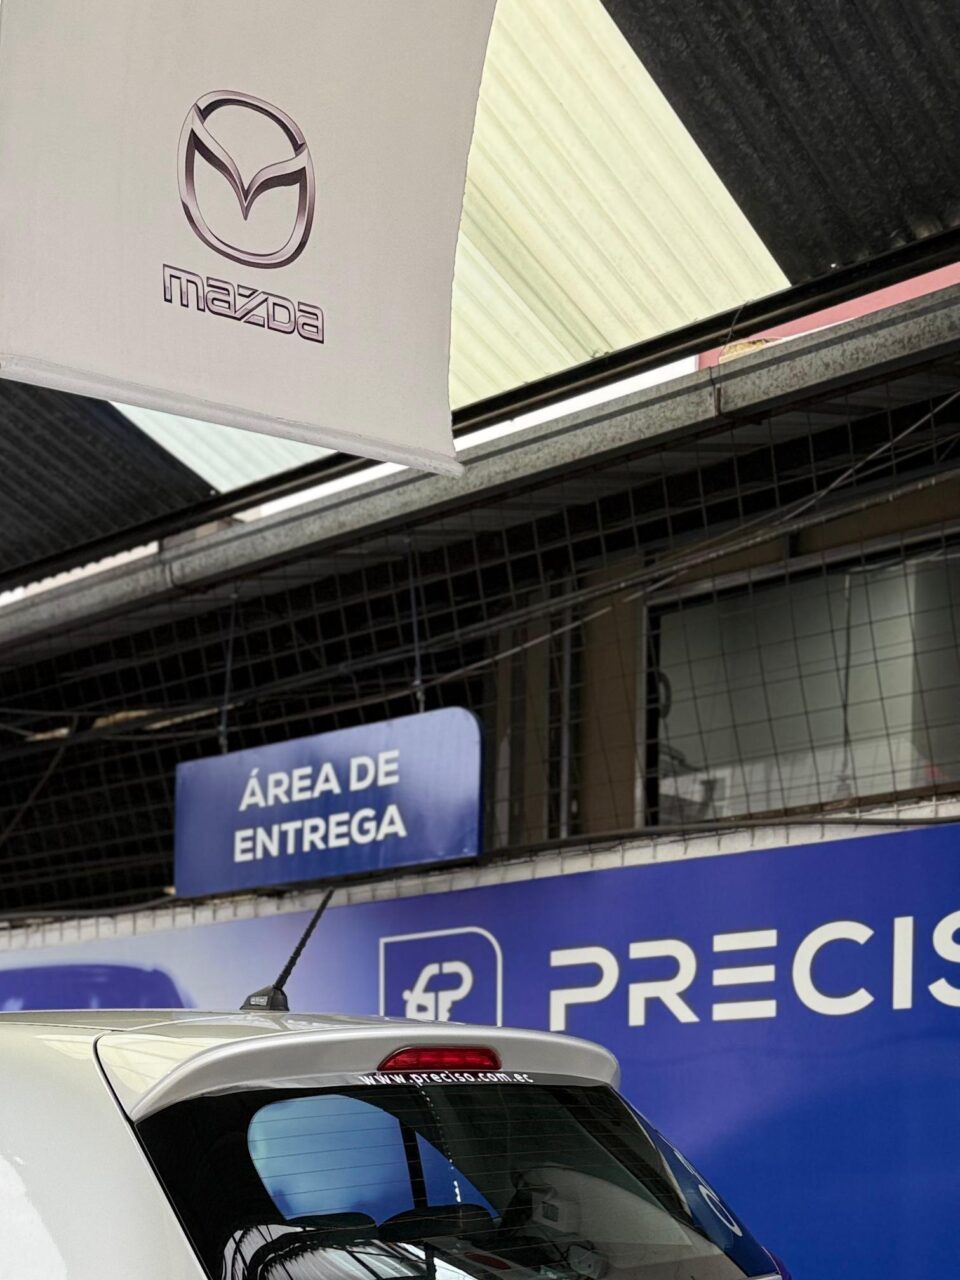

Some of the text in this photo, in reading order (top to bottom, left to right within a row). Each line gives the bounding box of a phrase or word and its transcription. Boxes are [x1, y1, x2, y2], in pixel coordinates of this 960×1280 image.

[238, 749, 400, 812] ÁREA DE
[233, 803, 408, 863] ENTREGA
[358, 1070, 534, 1089] www.preciso.com.ec
